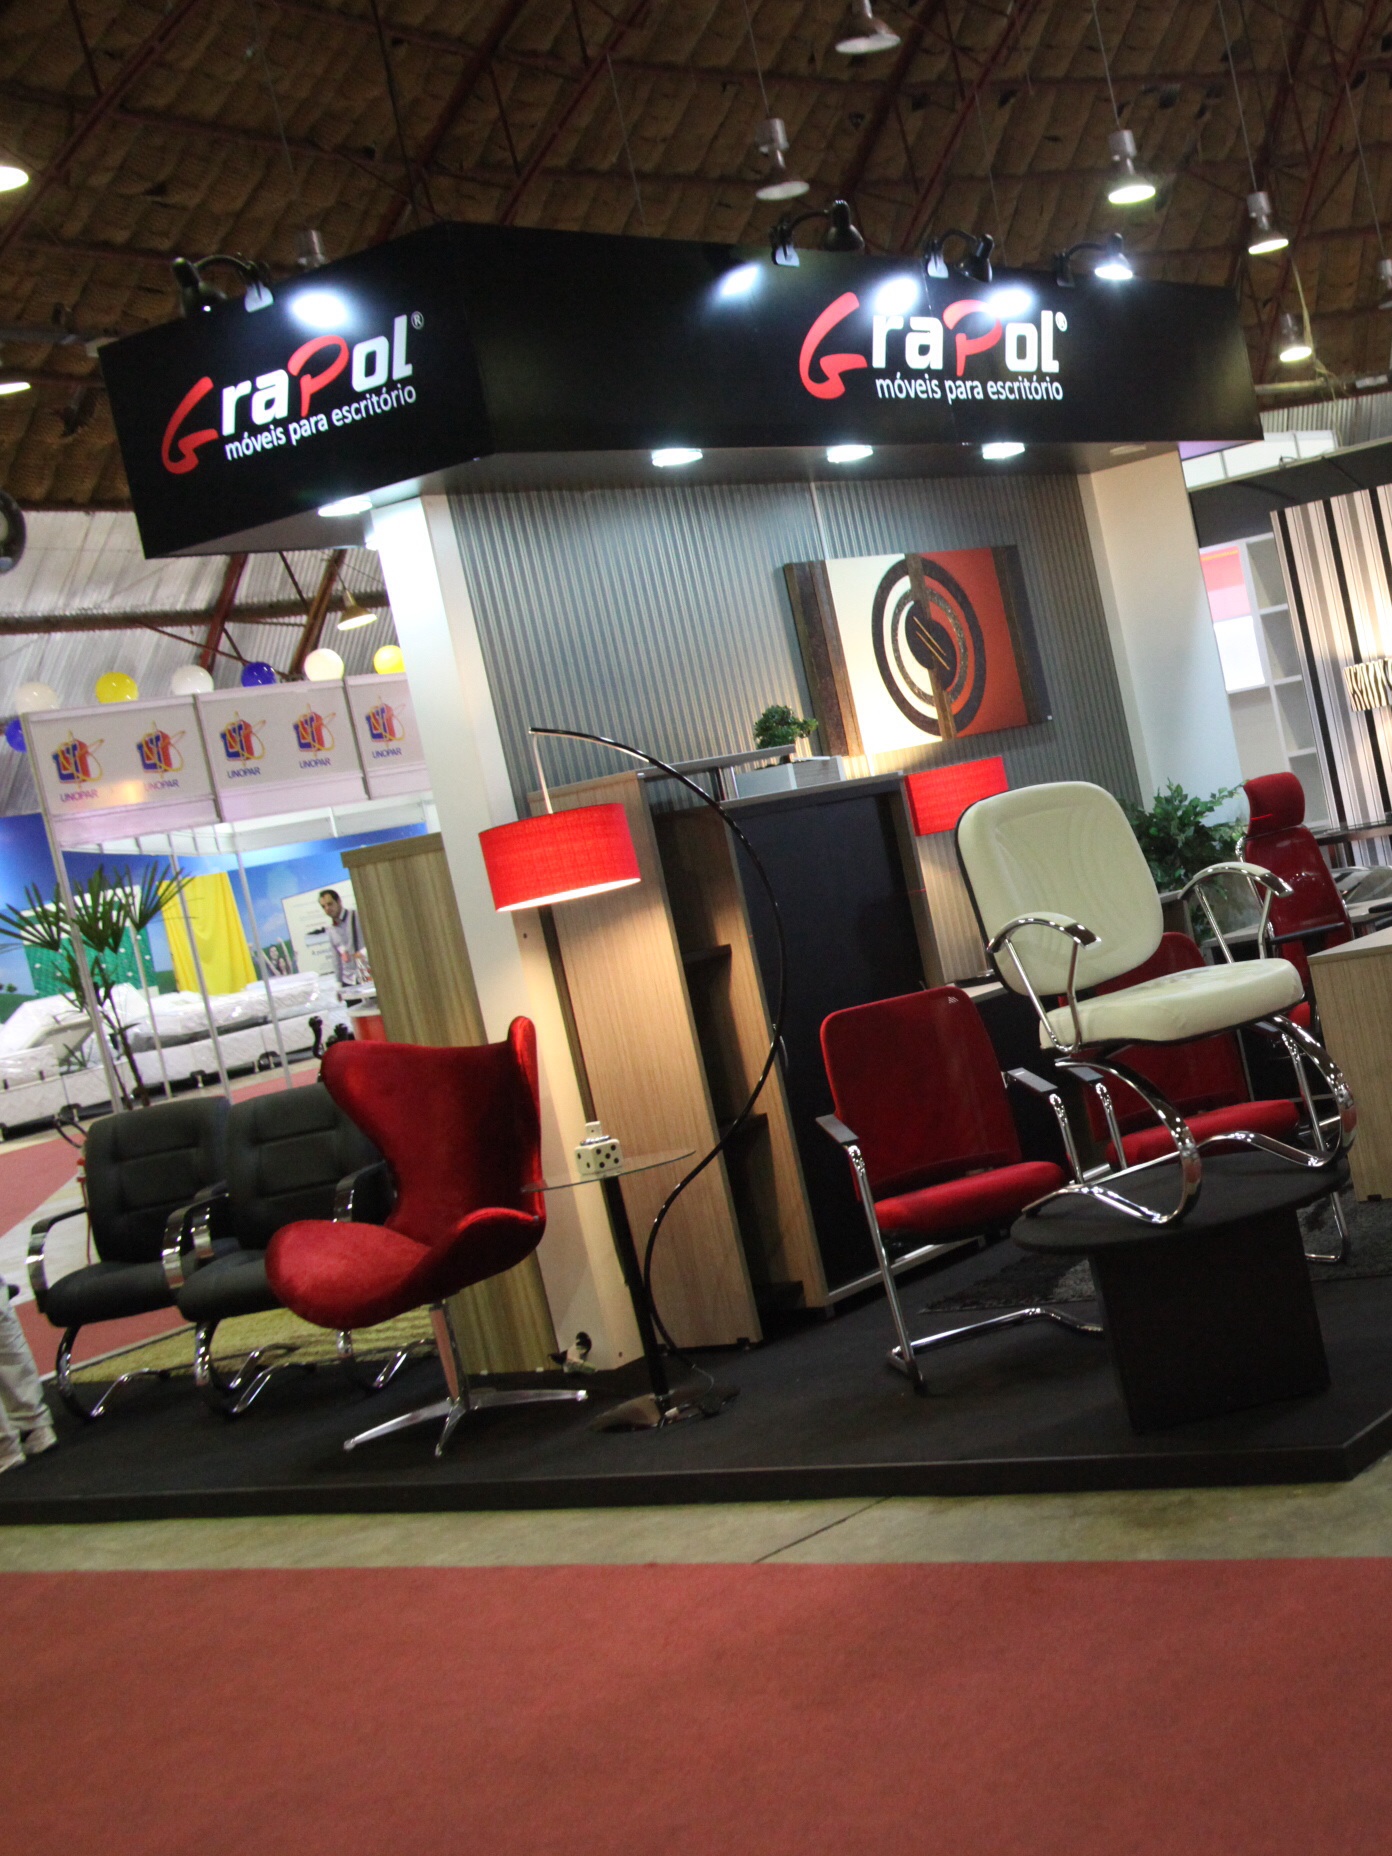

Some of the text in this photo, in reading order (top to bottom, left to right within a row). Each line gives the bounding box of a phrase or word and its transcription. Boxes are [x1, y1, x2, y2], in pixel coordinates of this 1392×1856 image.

[876, 372, 1063, 404] móveis para escritório
[225, 383, 416, 460] móveis para escritório
[372, 748, 402, 759] UNOPAR
[299, 758, 331, 769] UNOPAR
[227, 767, 260, 779] UNOPAR
[60, 789, 98, 802] UNOPAR
